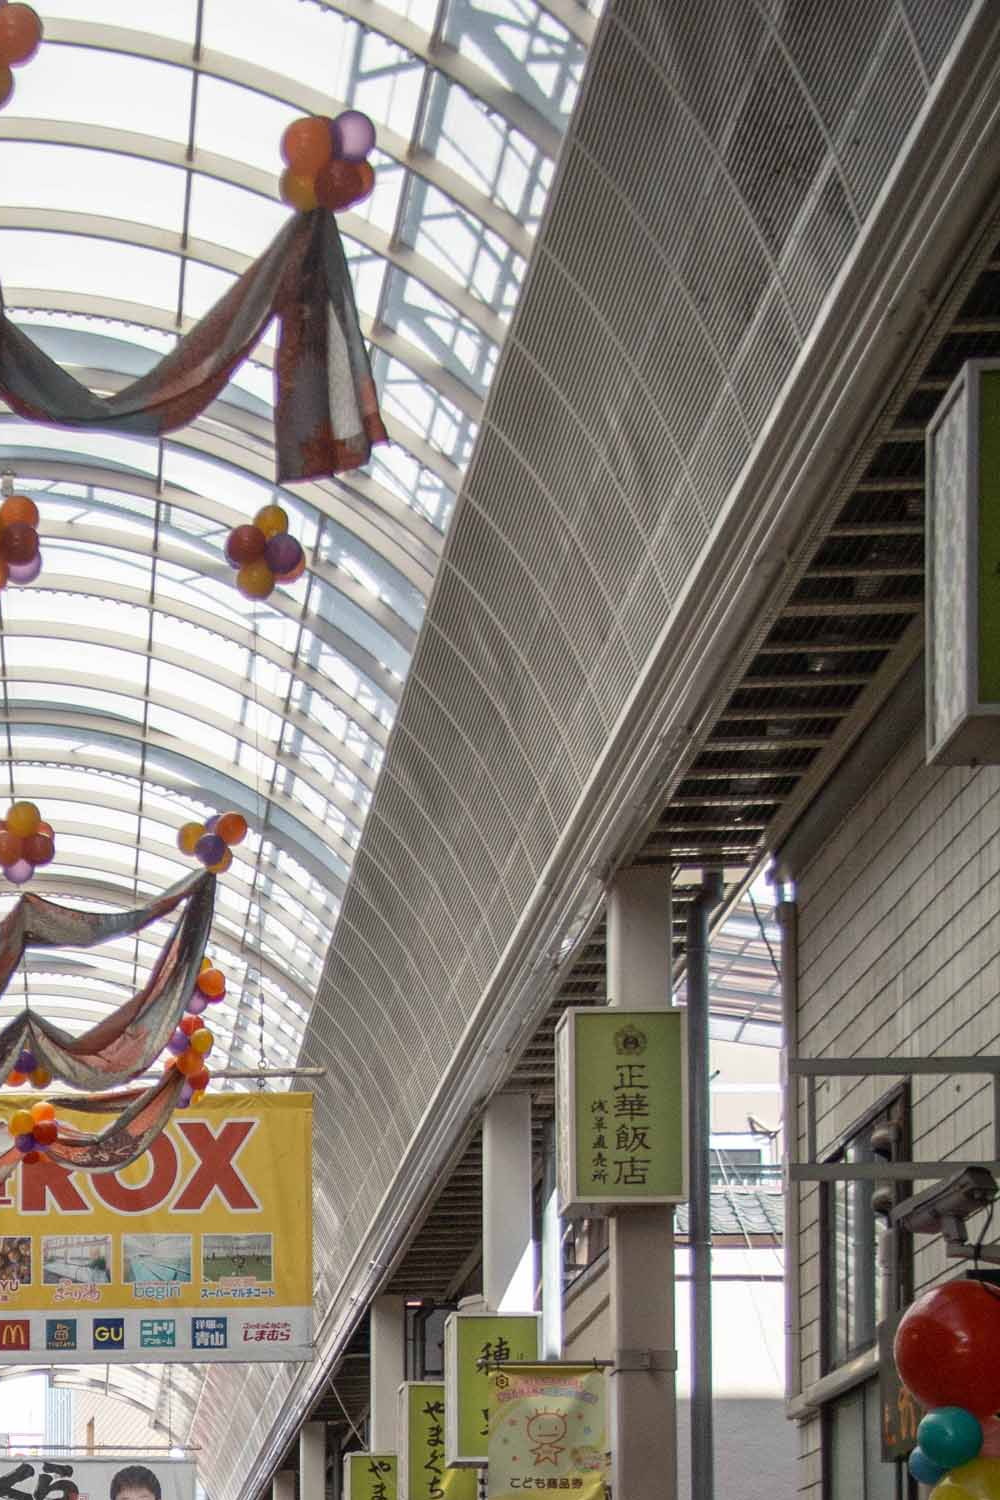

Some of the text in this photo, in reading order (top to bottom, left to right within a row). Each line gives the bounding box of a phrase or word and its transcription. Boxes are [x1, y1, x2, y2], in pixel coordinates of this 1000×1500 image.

[612, 1063, 652, 1186] 正華飯店
[21, 1120, 259, 1212] ROX
[133, 1283, 182, 1301] begin
[95, 1326, 123, 1342] GU
[142, 1321, 174, 1336] ニトリ
[242, 1329, 291, 1343] しまむら
[423, 1401, 445, 1500] やまぐち
[509, 1476, 584, 1489] こども商品券
